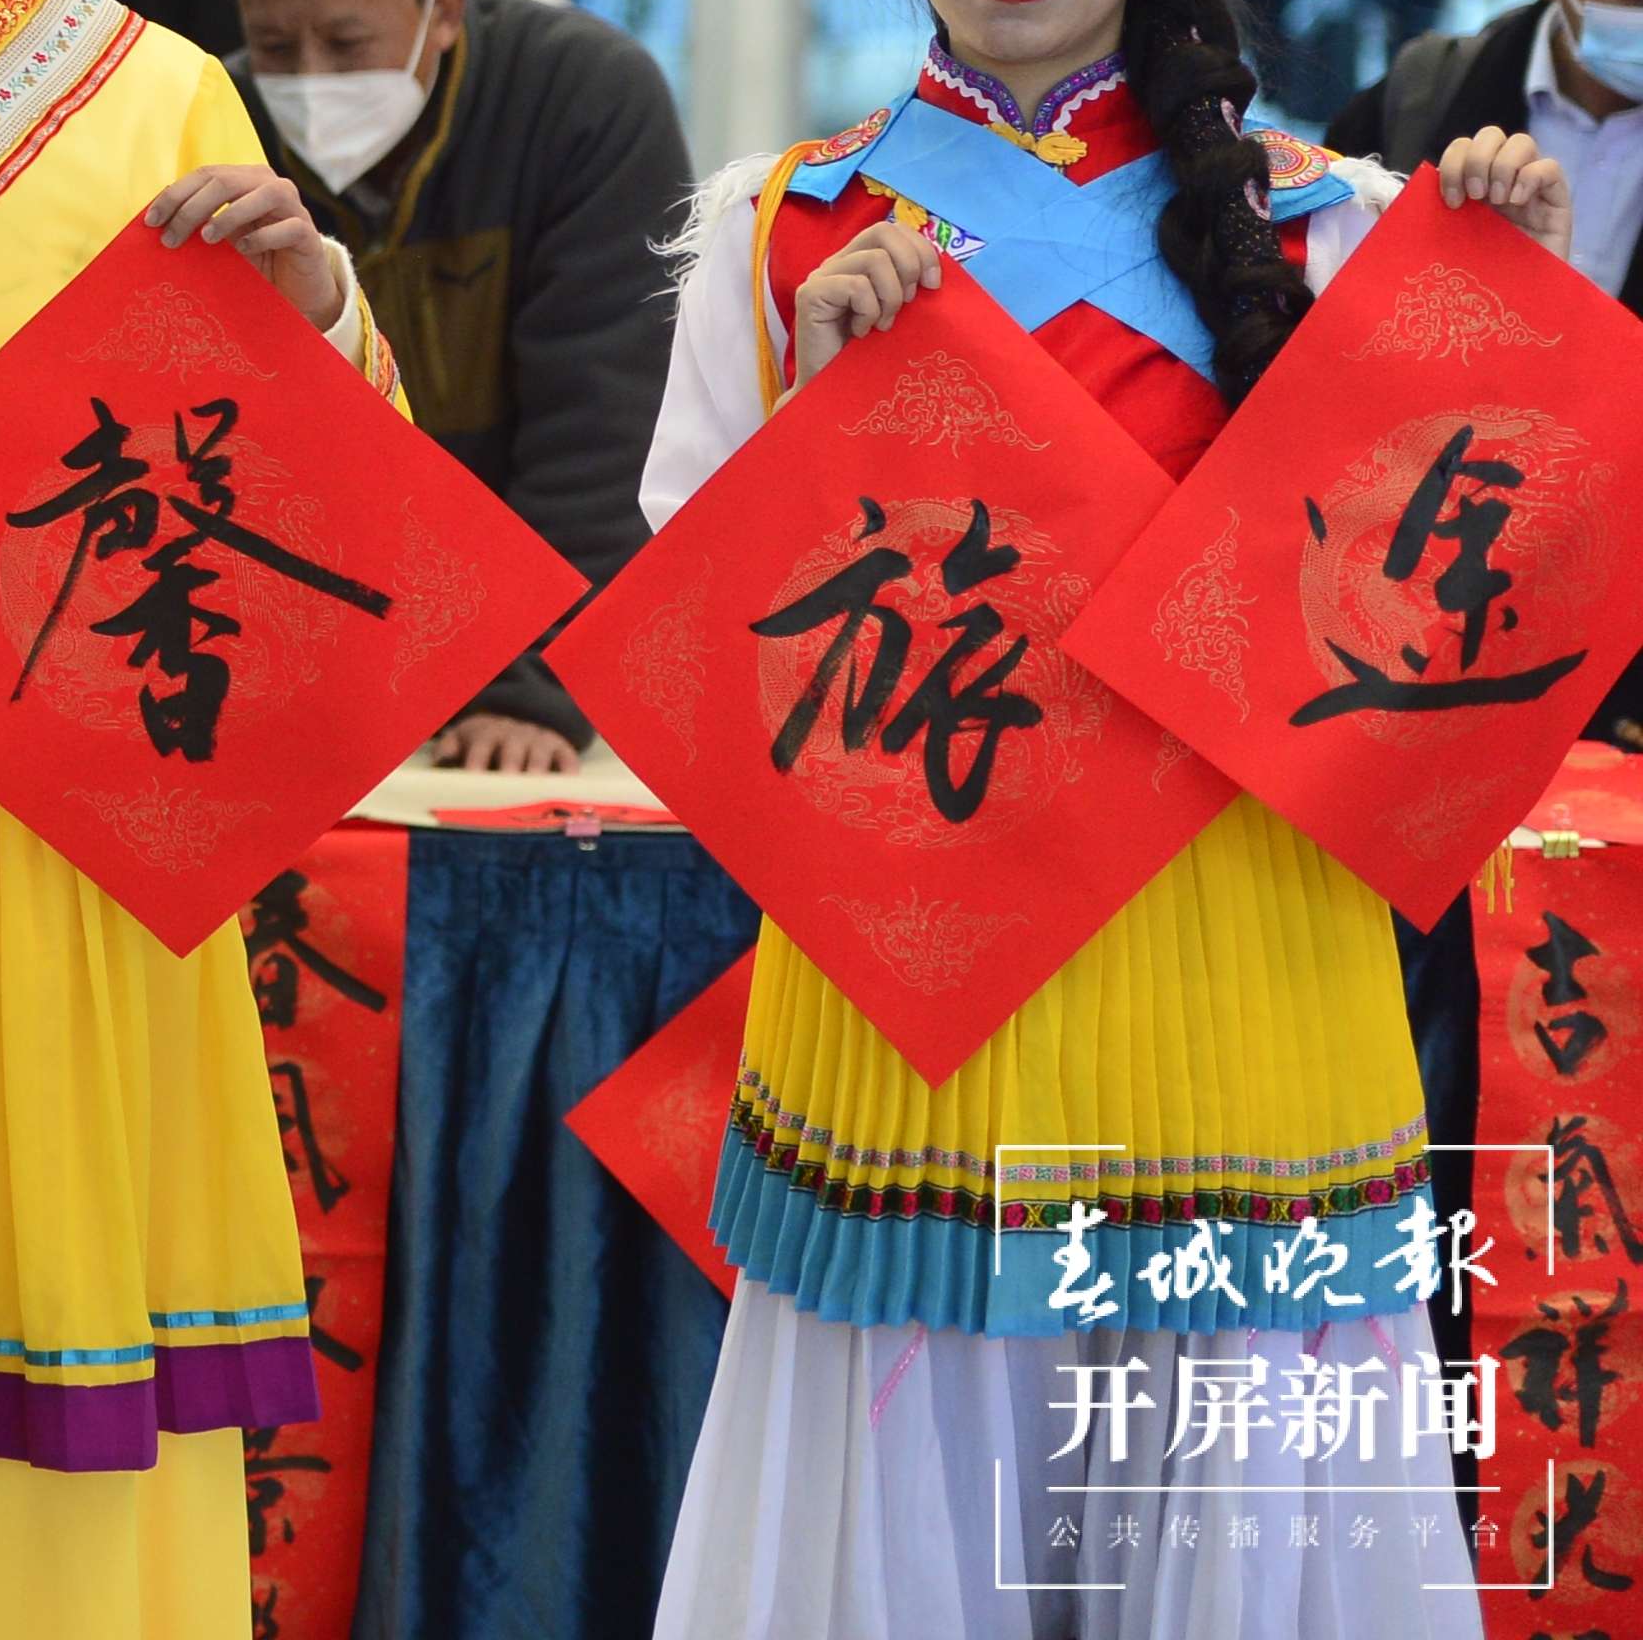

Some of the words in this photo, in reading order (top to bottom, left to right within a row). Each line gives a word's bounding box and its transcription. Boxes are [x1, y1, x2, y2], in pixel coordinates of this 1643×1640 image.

[7, 396, 391, 762] 馨
[749, 496, 1043, 824] 旅
[1289, 426, 1588, 727] 途
